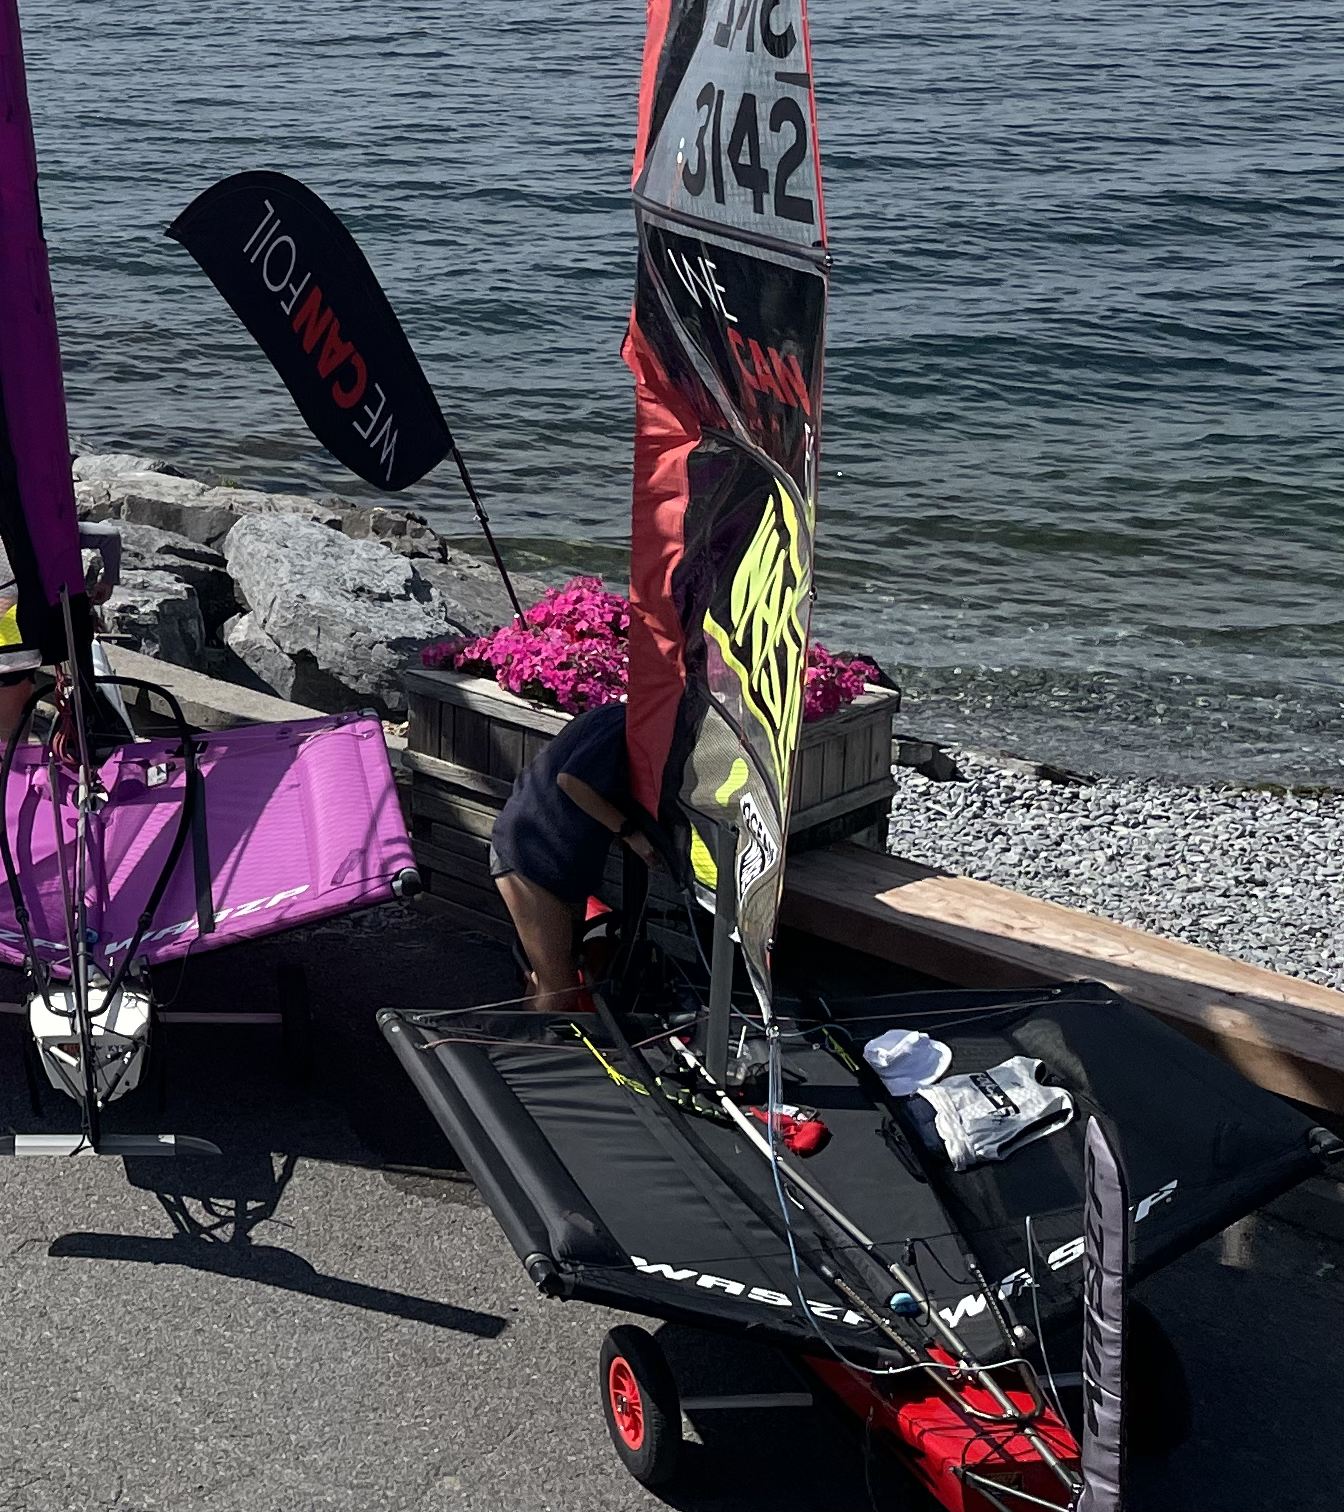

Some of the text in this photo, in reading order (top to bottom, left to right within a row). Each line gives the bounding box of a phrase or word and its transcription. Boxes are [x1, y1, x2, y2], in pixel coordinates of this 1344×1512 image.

[682, 81, 815, 225] 3142
[242, 198, 400, 482] WE CAN FOIL
[667, 248, 739, 323] WE
[727, 326, 811, 416] CAN
[938, 1178, 1179, 1329] WASP
